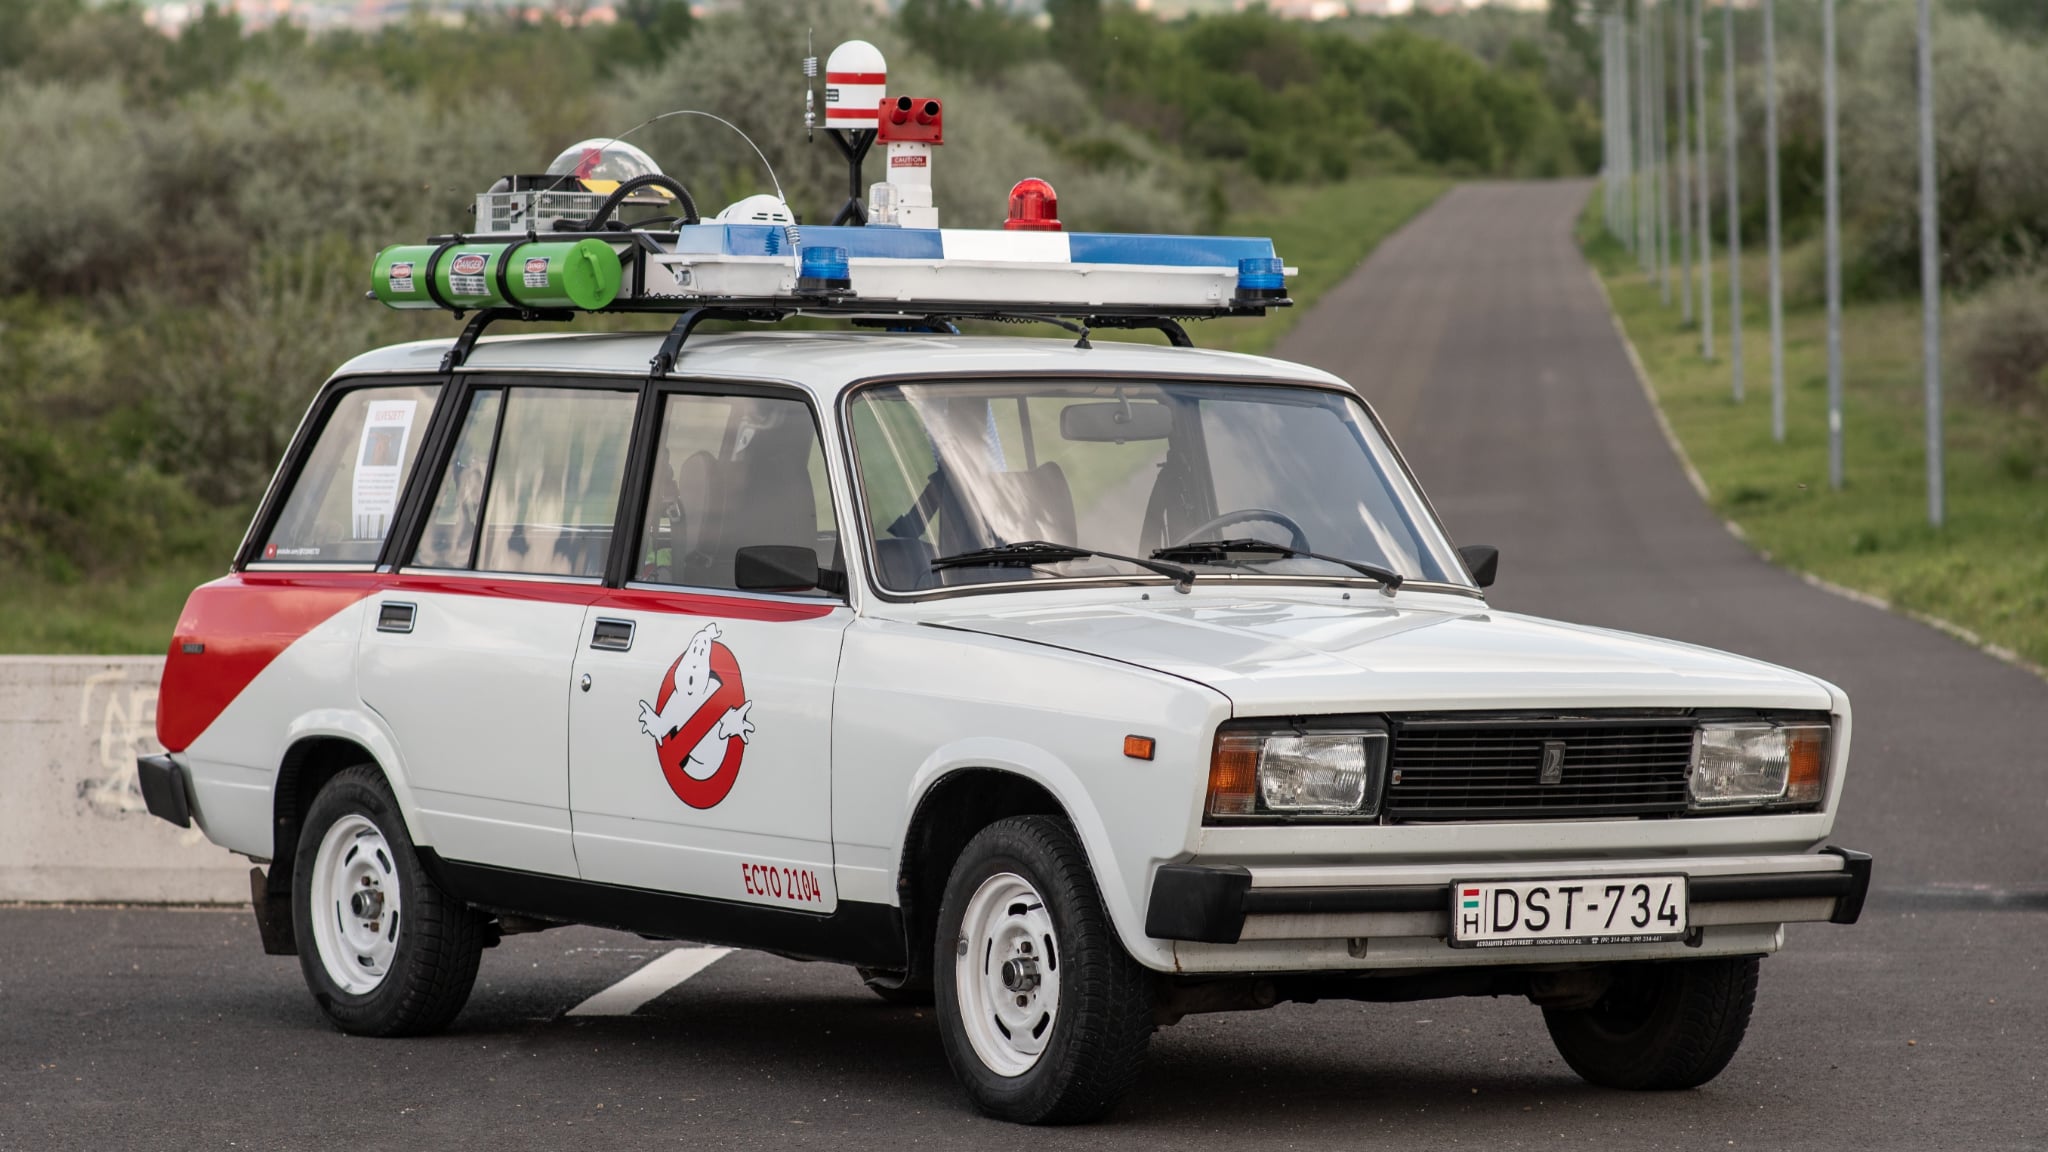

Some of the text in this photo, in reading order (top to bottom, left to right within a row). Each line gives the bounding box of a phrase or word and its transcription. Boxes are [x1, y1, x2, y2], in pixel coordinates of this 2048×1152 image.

[455, 259, 483, 270] DANGER
[741, 863, 822, 903] ECTO 2104
[1492, 883, 1679, 933] DST-734
[1463, 913, 1479, 935] H
